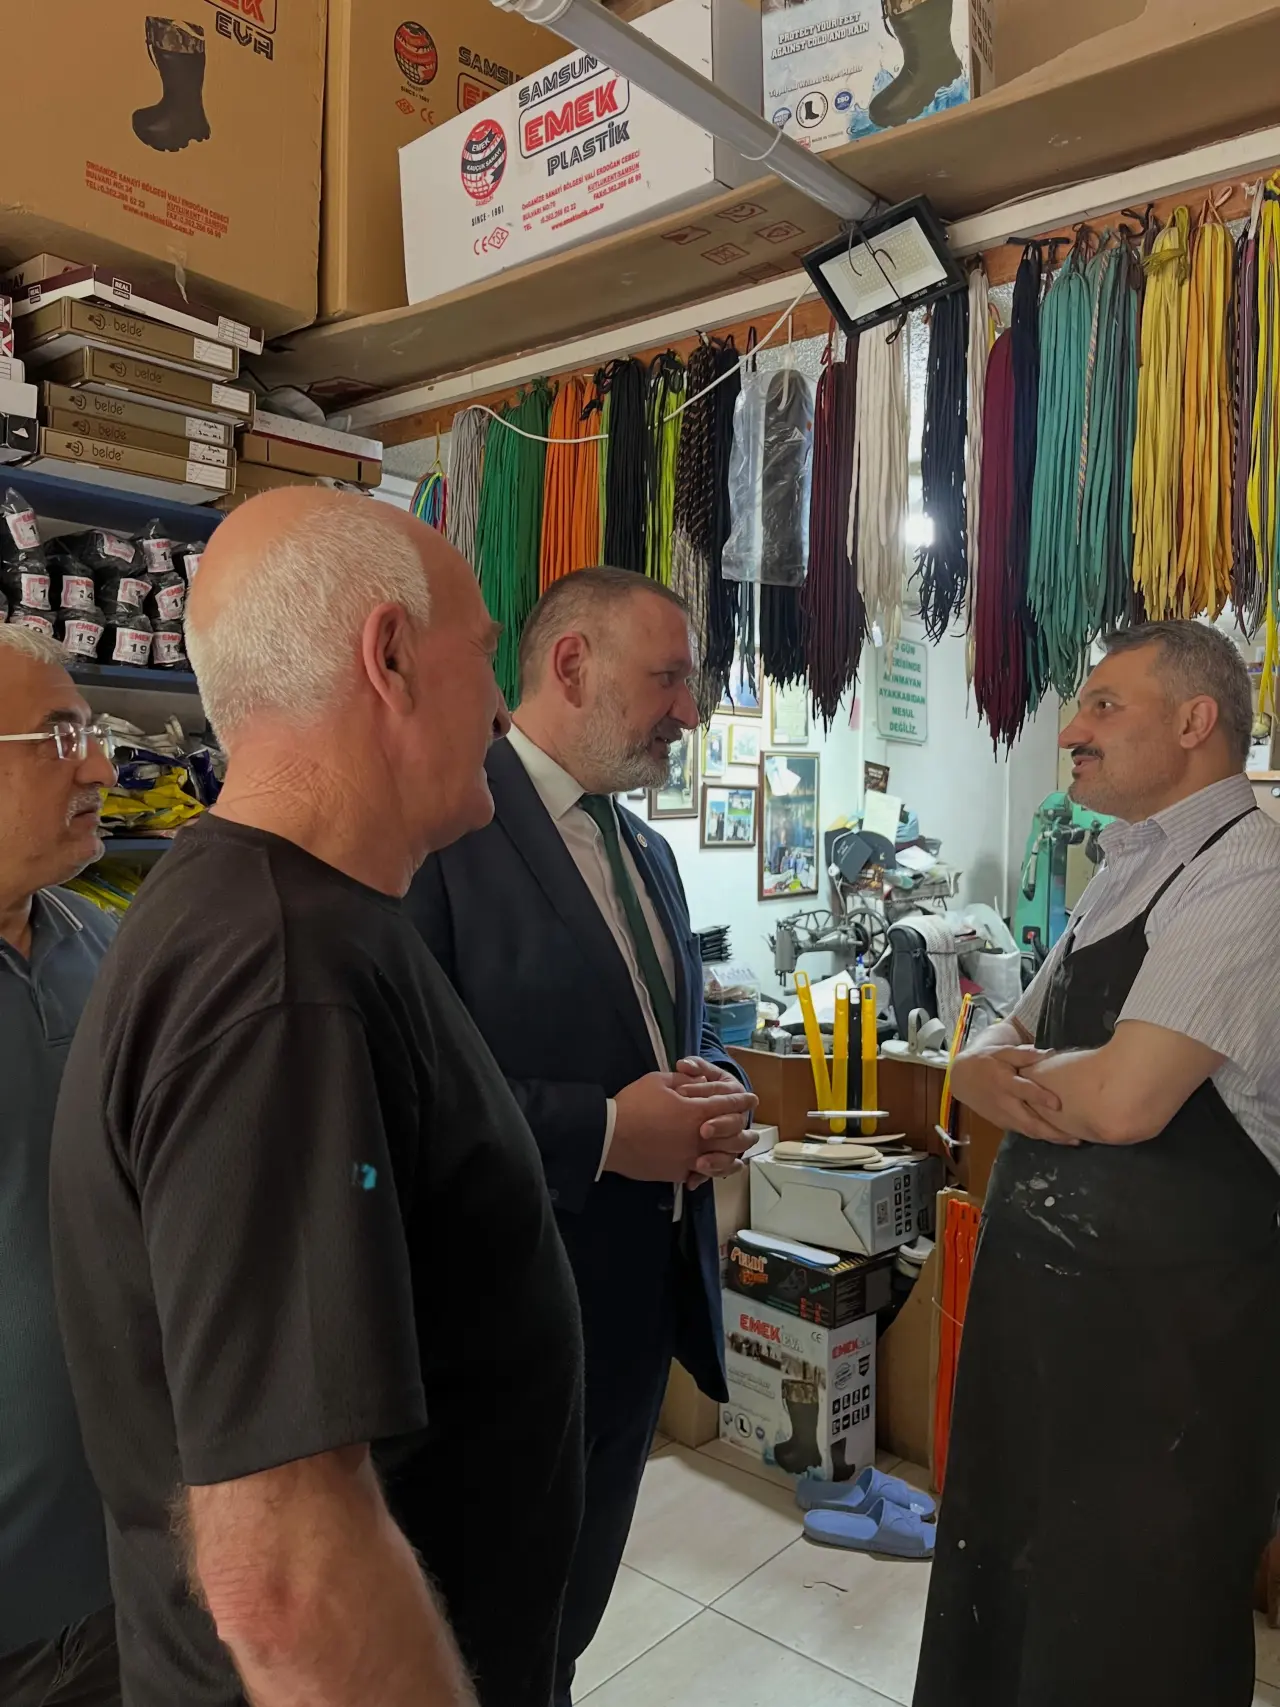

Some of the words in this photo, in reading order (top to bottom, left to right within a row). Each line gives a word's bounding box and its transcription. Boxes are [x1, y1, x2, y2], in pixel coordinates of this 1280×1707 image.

[216, 11, 273, 61] EVA
[779, 25, 815, 44] PROTECT
[815, 18, 838, 34] YOUR
[839, 11, 861, 27] FEET
[771, 40, 806, 60] AGAINST
[807, 32, 828, 49] COLD
[828, 28, 847, 43] AND
[847, 22, 870, 37] RAIN
[459, 46, 524, 86] SAMSU
[518, 54, 599, 109] SAMSUN
[524, 79, 619, 152] EMEK
[471, 137, 490, 152] EMEK
[546, 120, 631, 177] PLASTİK
[114, 280, 130, 293] REAL
[113, 316, 143, 337] belde
[134, 364, 162, 383] belde
[94, 396, 124, 415] belde
[98, 422, 127, 440] belde
[92, 443, 122, 461] belde
[76, 623, 99, 634] EMEK
[76, 633, 97, 646] 19
[130, 643, 148, 655] 19
[878, 687, 926, 705] AYAKKABIDAN
[740, 1314, 781, 1343] EMEK
[811, 1331, 823, 1343] CE
